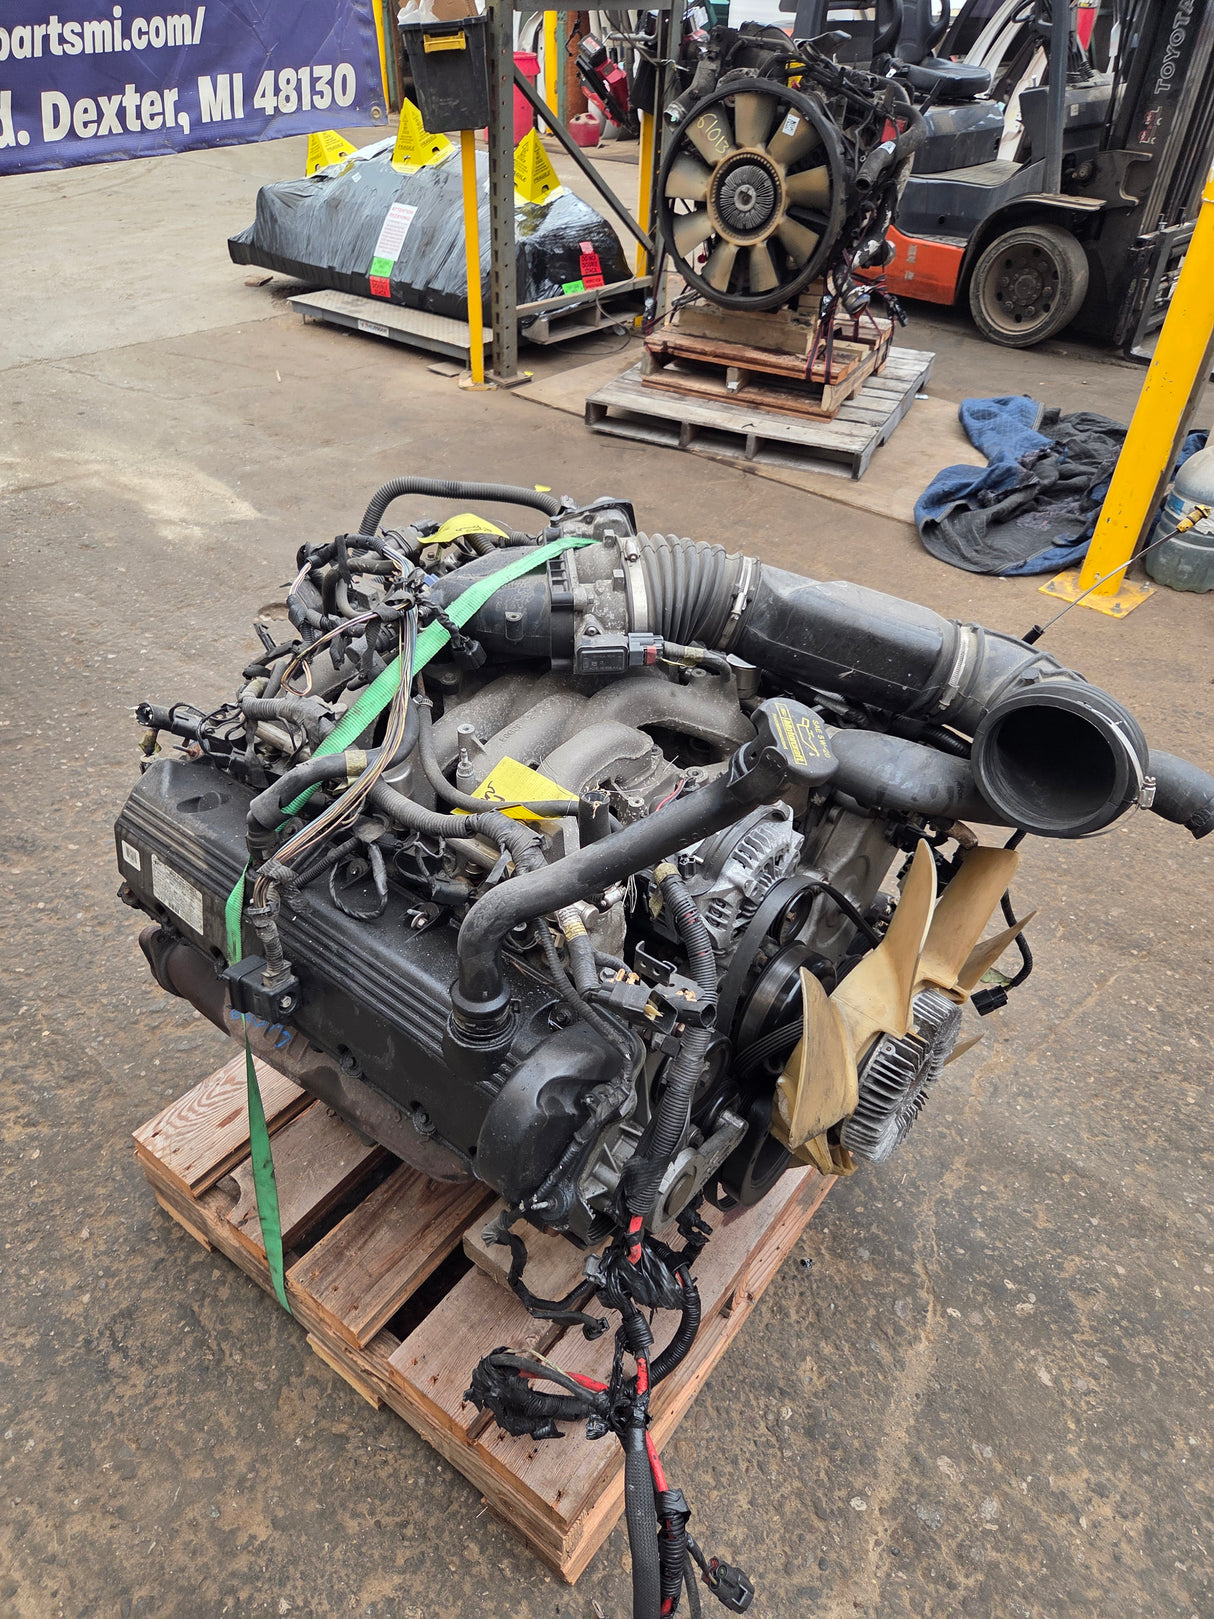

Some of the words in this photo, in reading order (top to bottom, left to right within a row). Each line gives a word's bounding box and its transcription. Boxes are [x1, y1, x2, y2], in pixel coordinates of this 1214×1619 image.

[41, 83, 191, 142] Dexter,
[198, 73, 244, 123] MI
[253, 63, 356, 115] 48130
